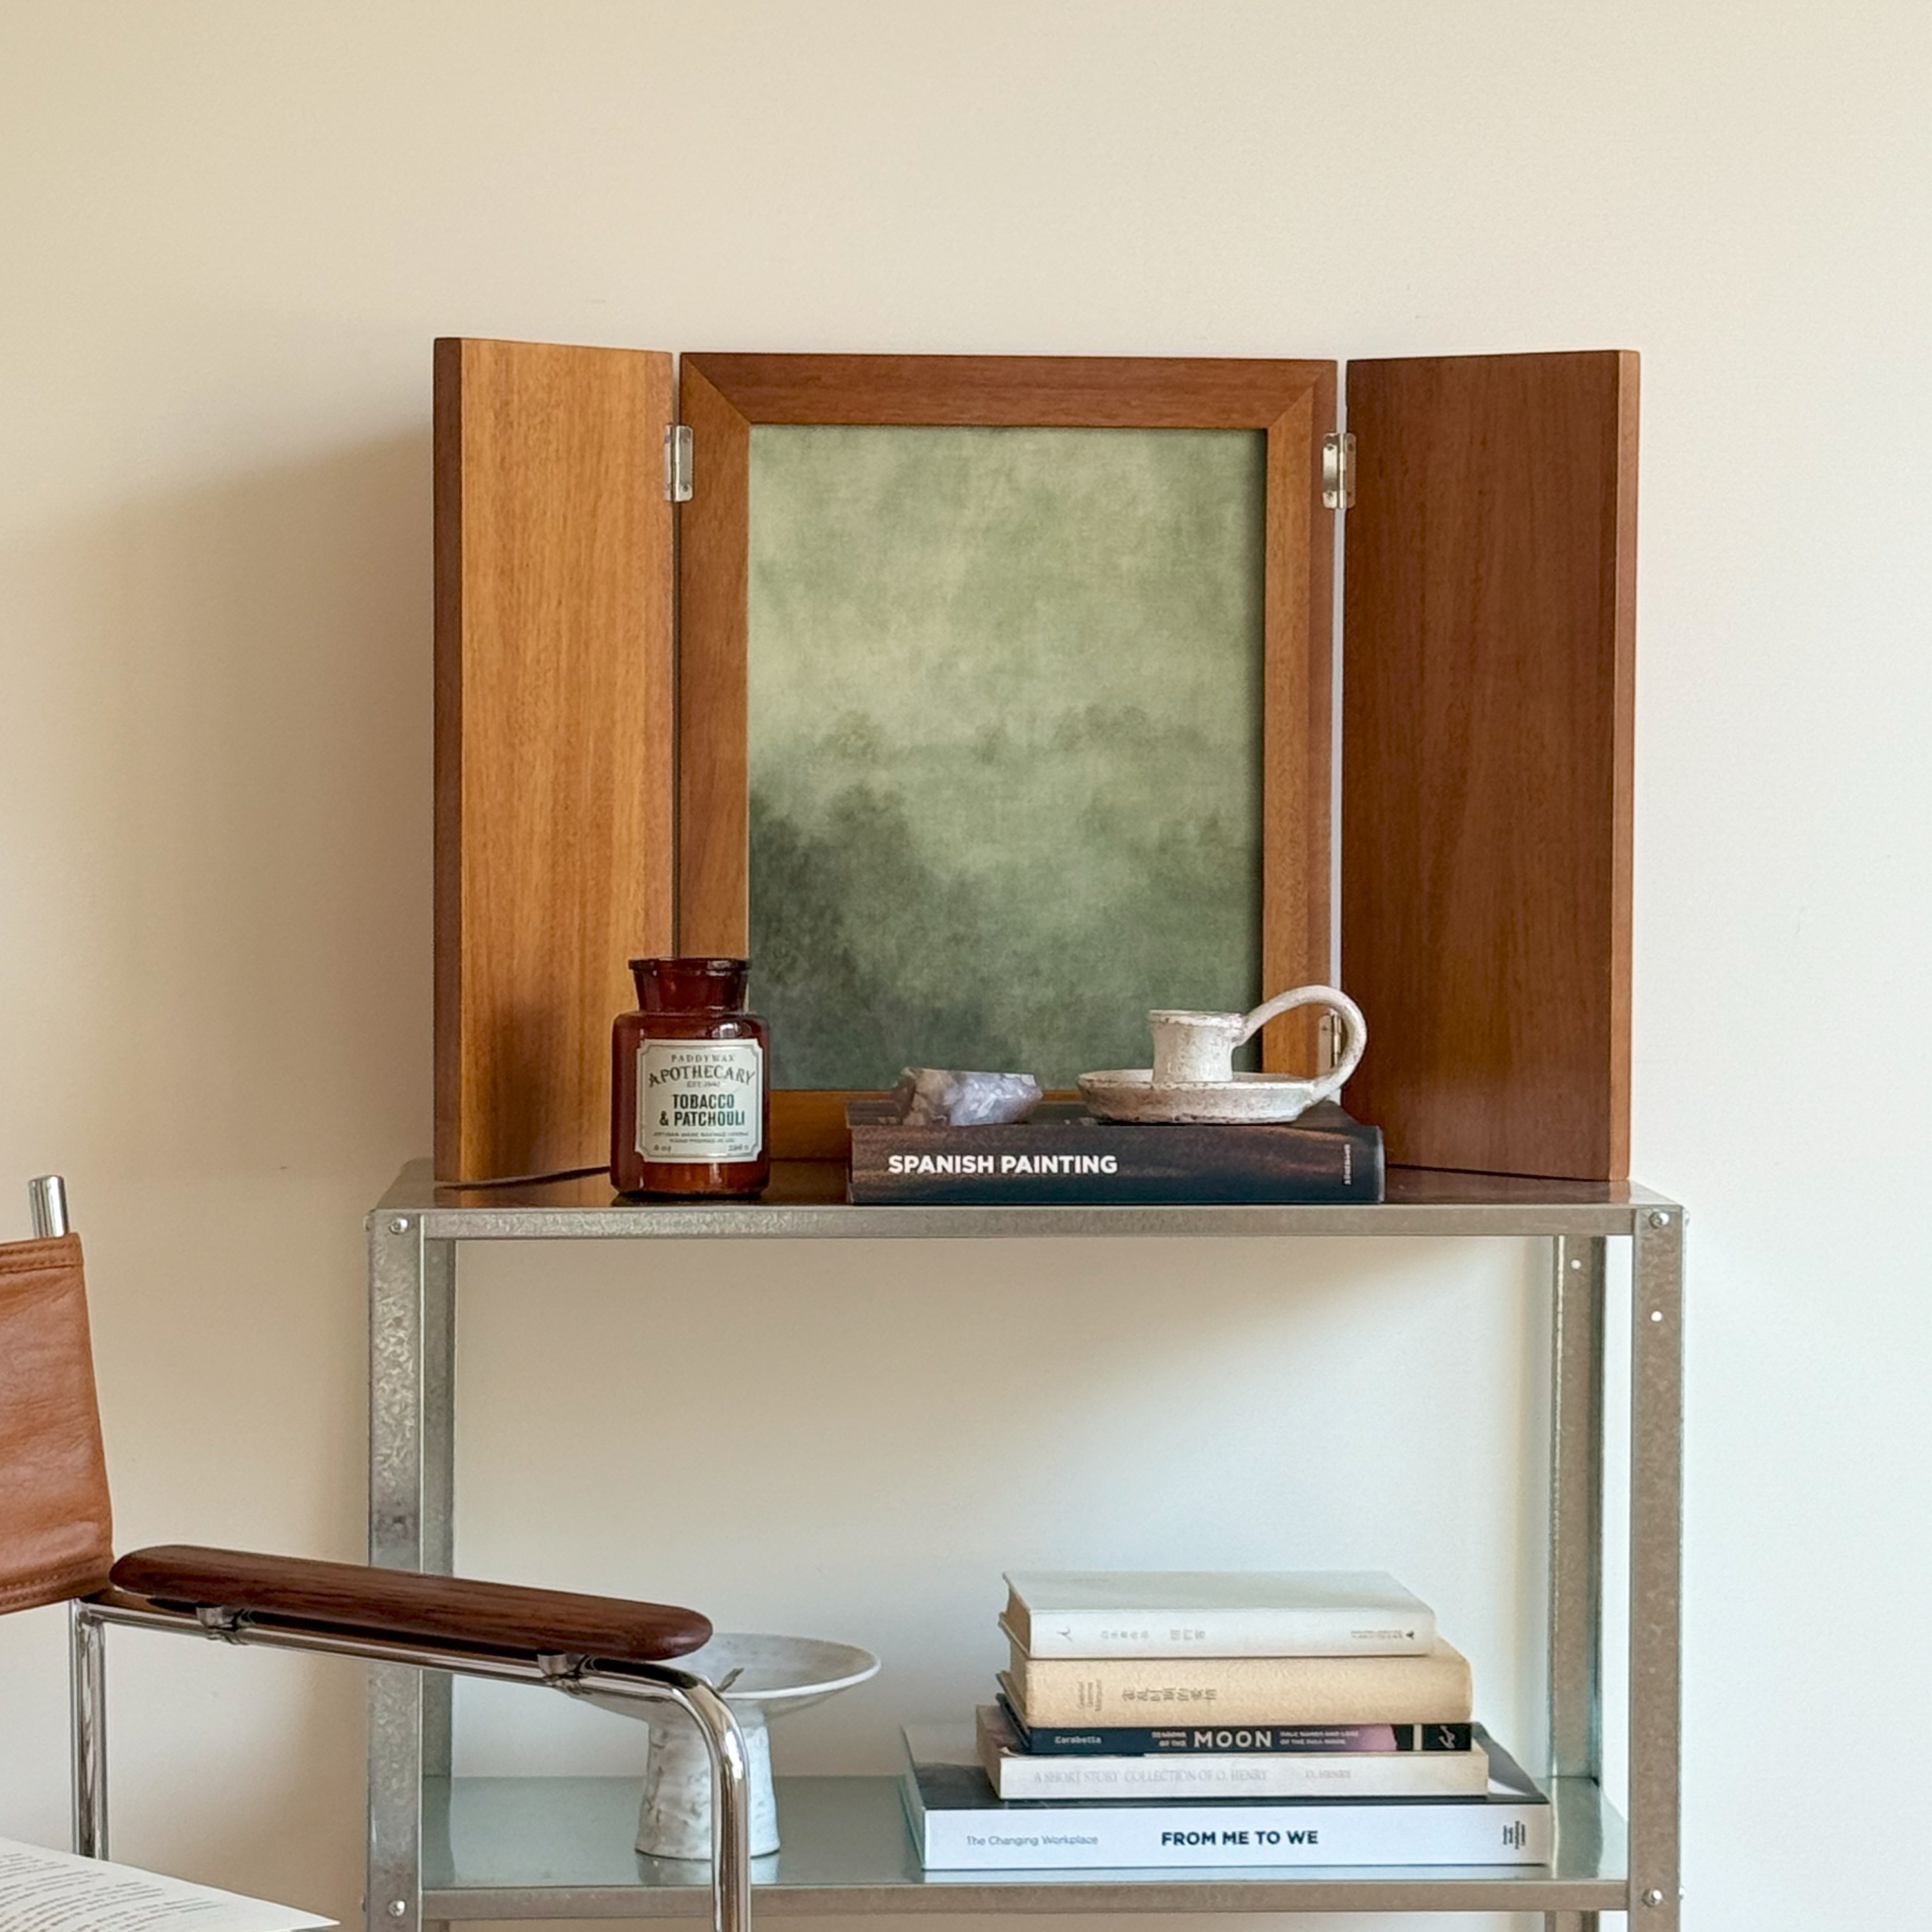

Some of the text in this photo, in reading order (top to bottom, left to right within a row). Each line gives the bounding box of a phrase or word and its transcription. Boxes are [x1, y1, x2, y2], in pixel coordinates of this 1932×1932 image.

[671, 1054, 735, 1063] PADDYWAX
[648, 1065, 755, 1088] APOTHECARY
[672, 1094, 735, 1109] TOBACCO
[659, 1110, 745, 1126] & PATCHOULI
[888, 1155, 1118, 1175] SPANISH PAINTING
[1193, 1730, 1272, 1748] MOON
[1034, 1771, 1042, 1783] A
[1044, 1770, 1080, 1783] SHORT
[1084, 1770, 1119, 1783] STORY
[1124, 1770, 1197, 1783] COLLECTION
[1198, 1770, 1213, 1782] OF
[1231, 1768, 1268, 1782] HENRY
[1319, 1769, 1352, 1779] HENRY
[967, 1834, 1099, 1847] The Changing Workplace
[1161, 1830, 1319, 1846] FROM ME TO WE
